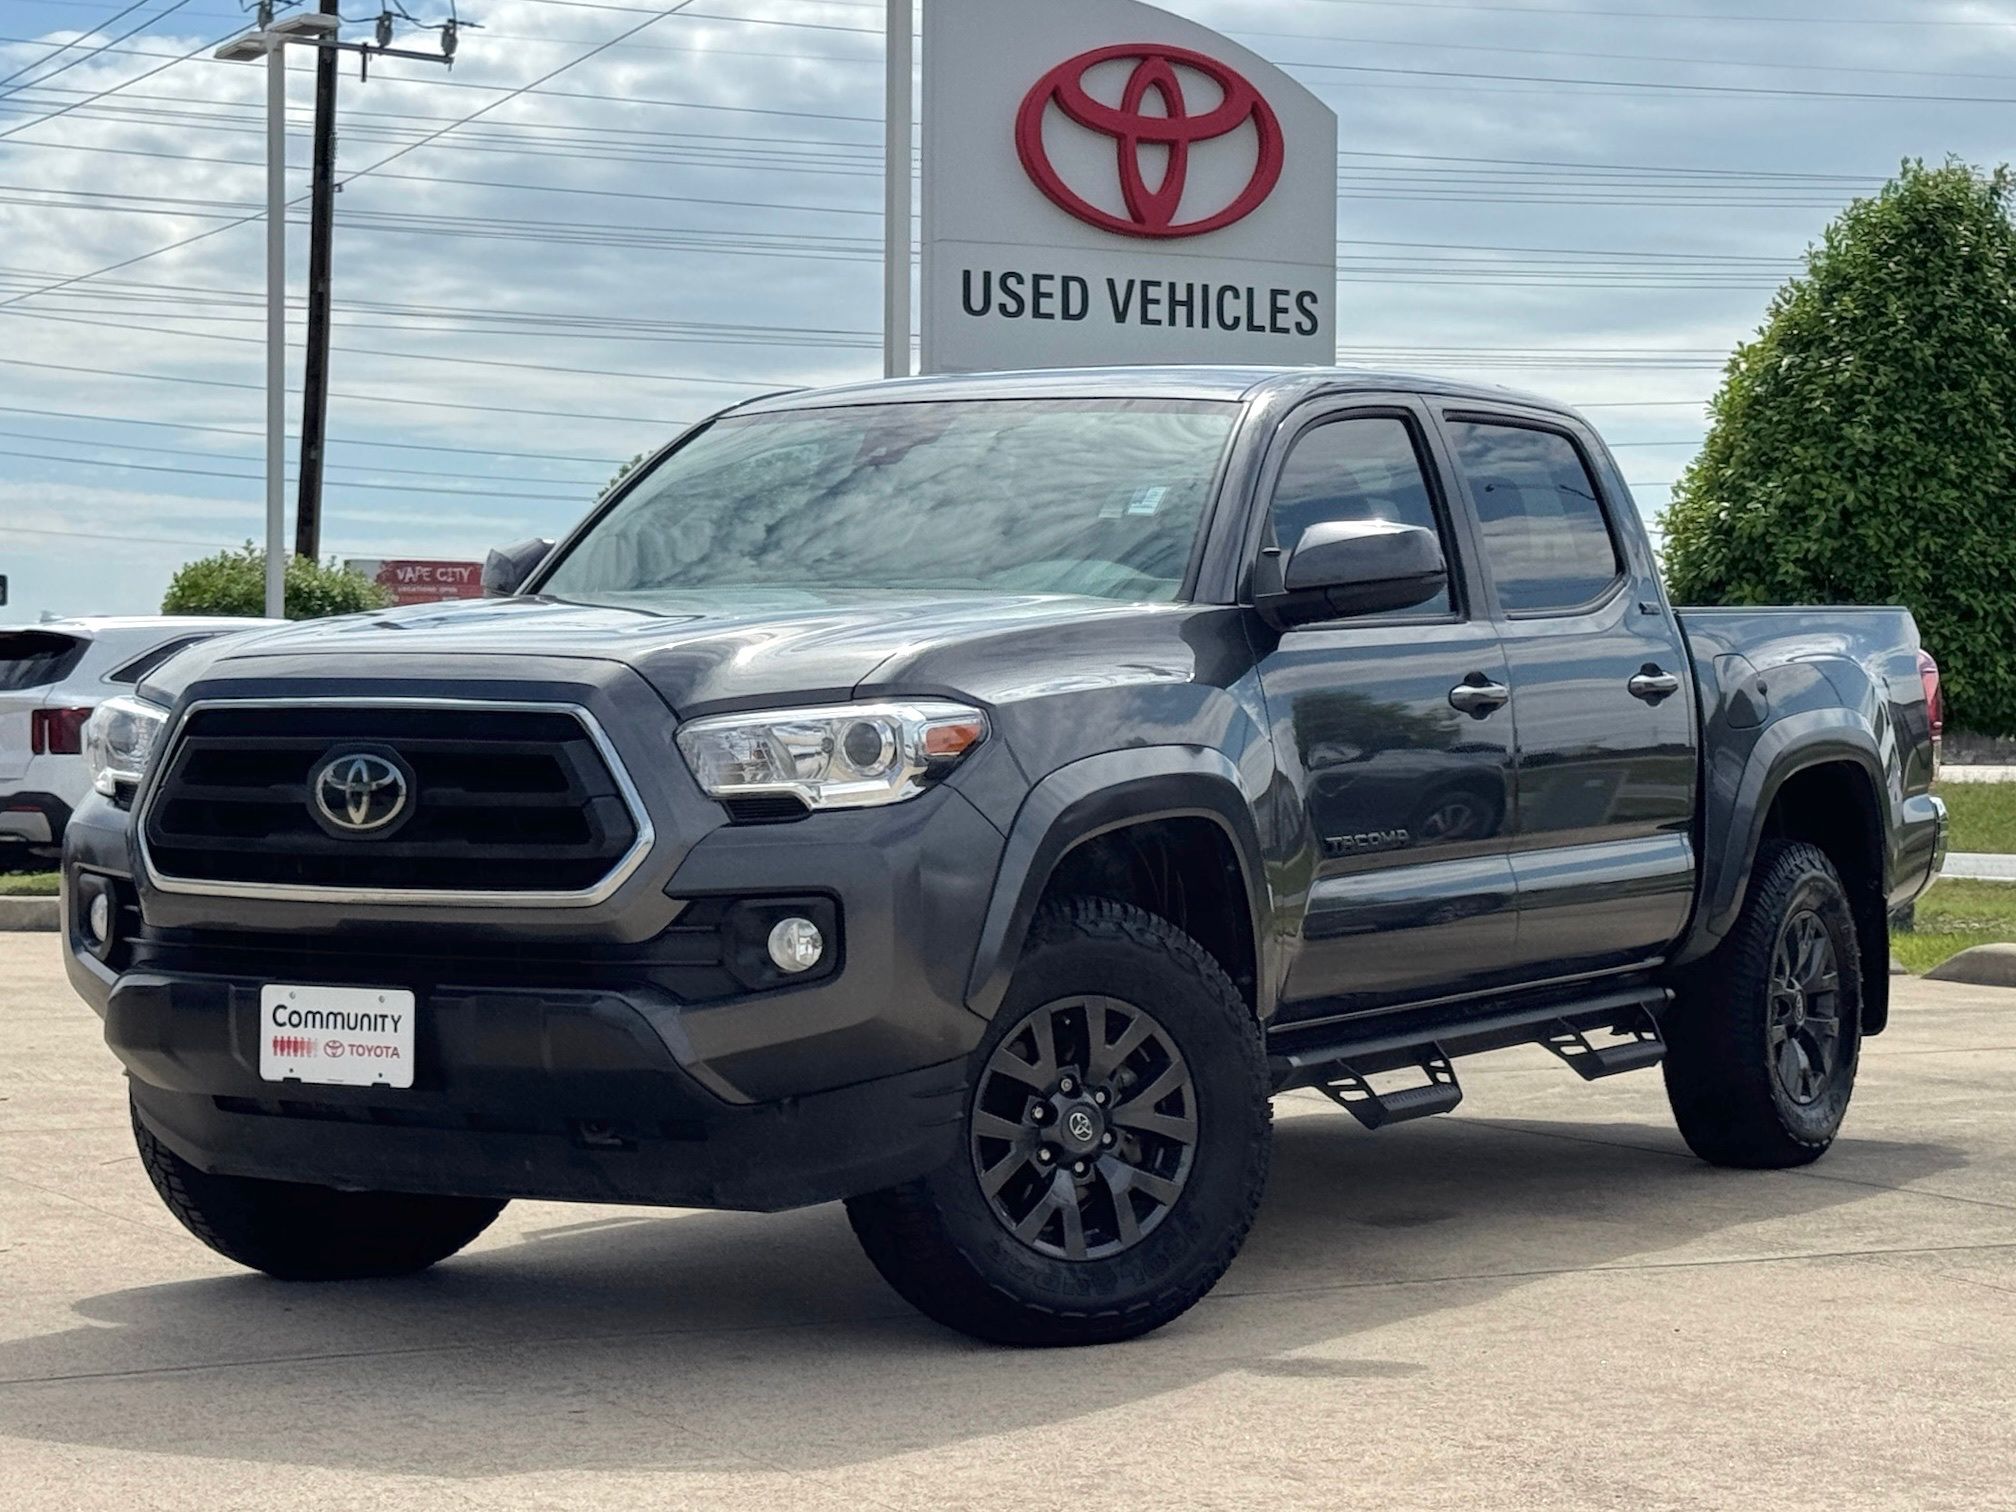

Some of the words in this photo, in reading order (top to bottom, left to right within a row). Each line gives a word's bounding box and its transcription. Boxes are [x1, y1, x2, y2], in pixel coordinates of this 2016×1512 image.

[962, 269, 1090, 321] USED
[1106, 278, 1319, 336] VEHICLES
[396, 565, 432, 583] VAPE
[436, 566, 473, 583] CITY
[1325, 829, 1409, 850] TACOMA
[348, 1043, 401, 1059] TOYOTA
